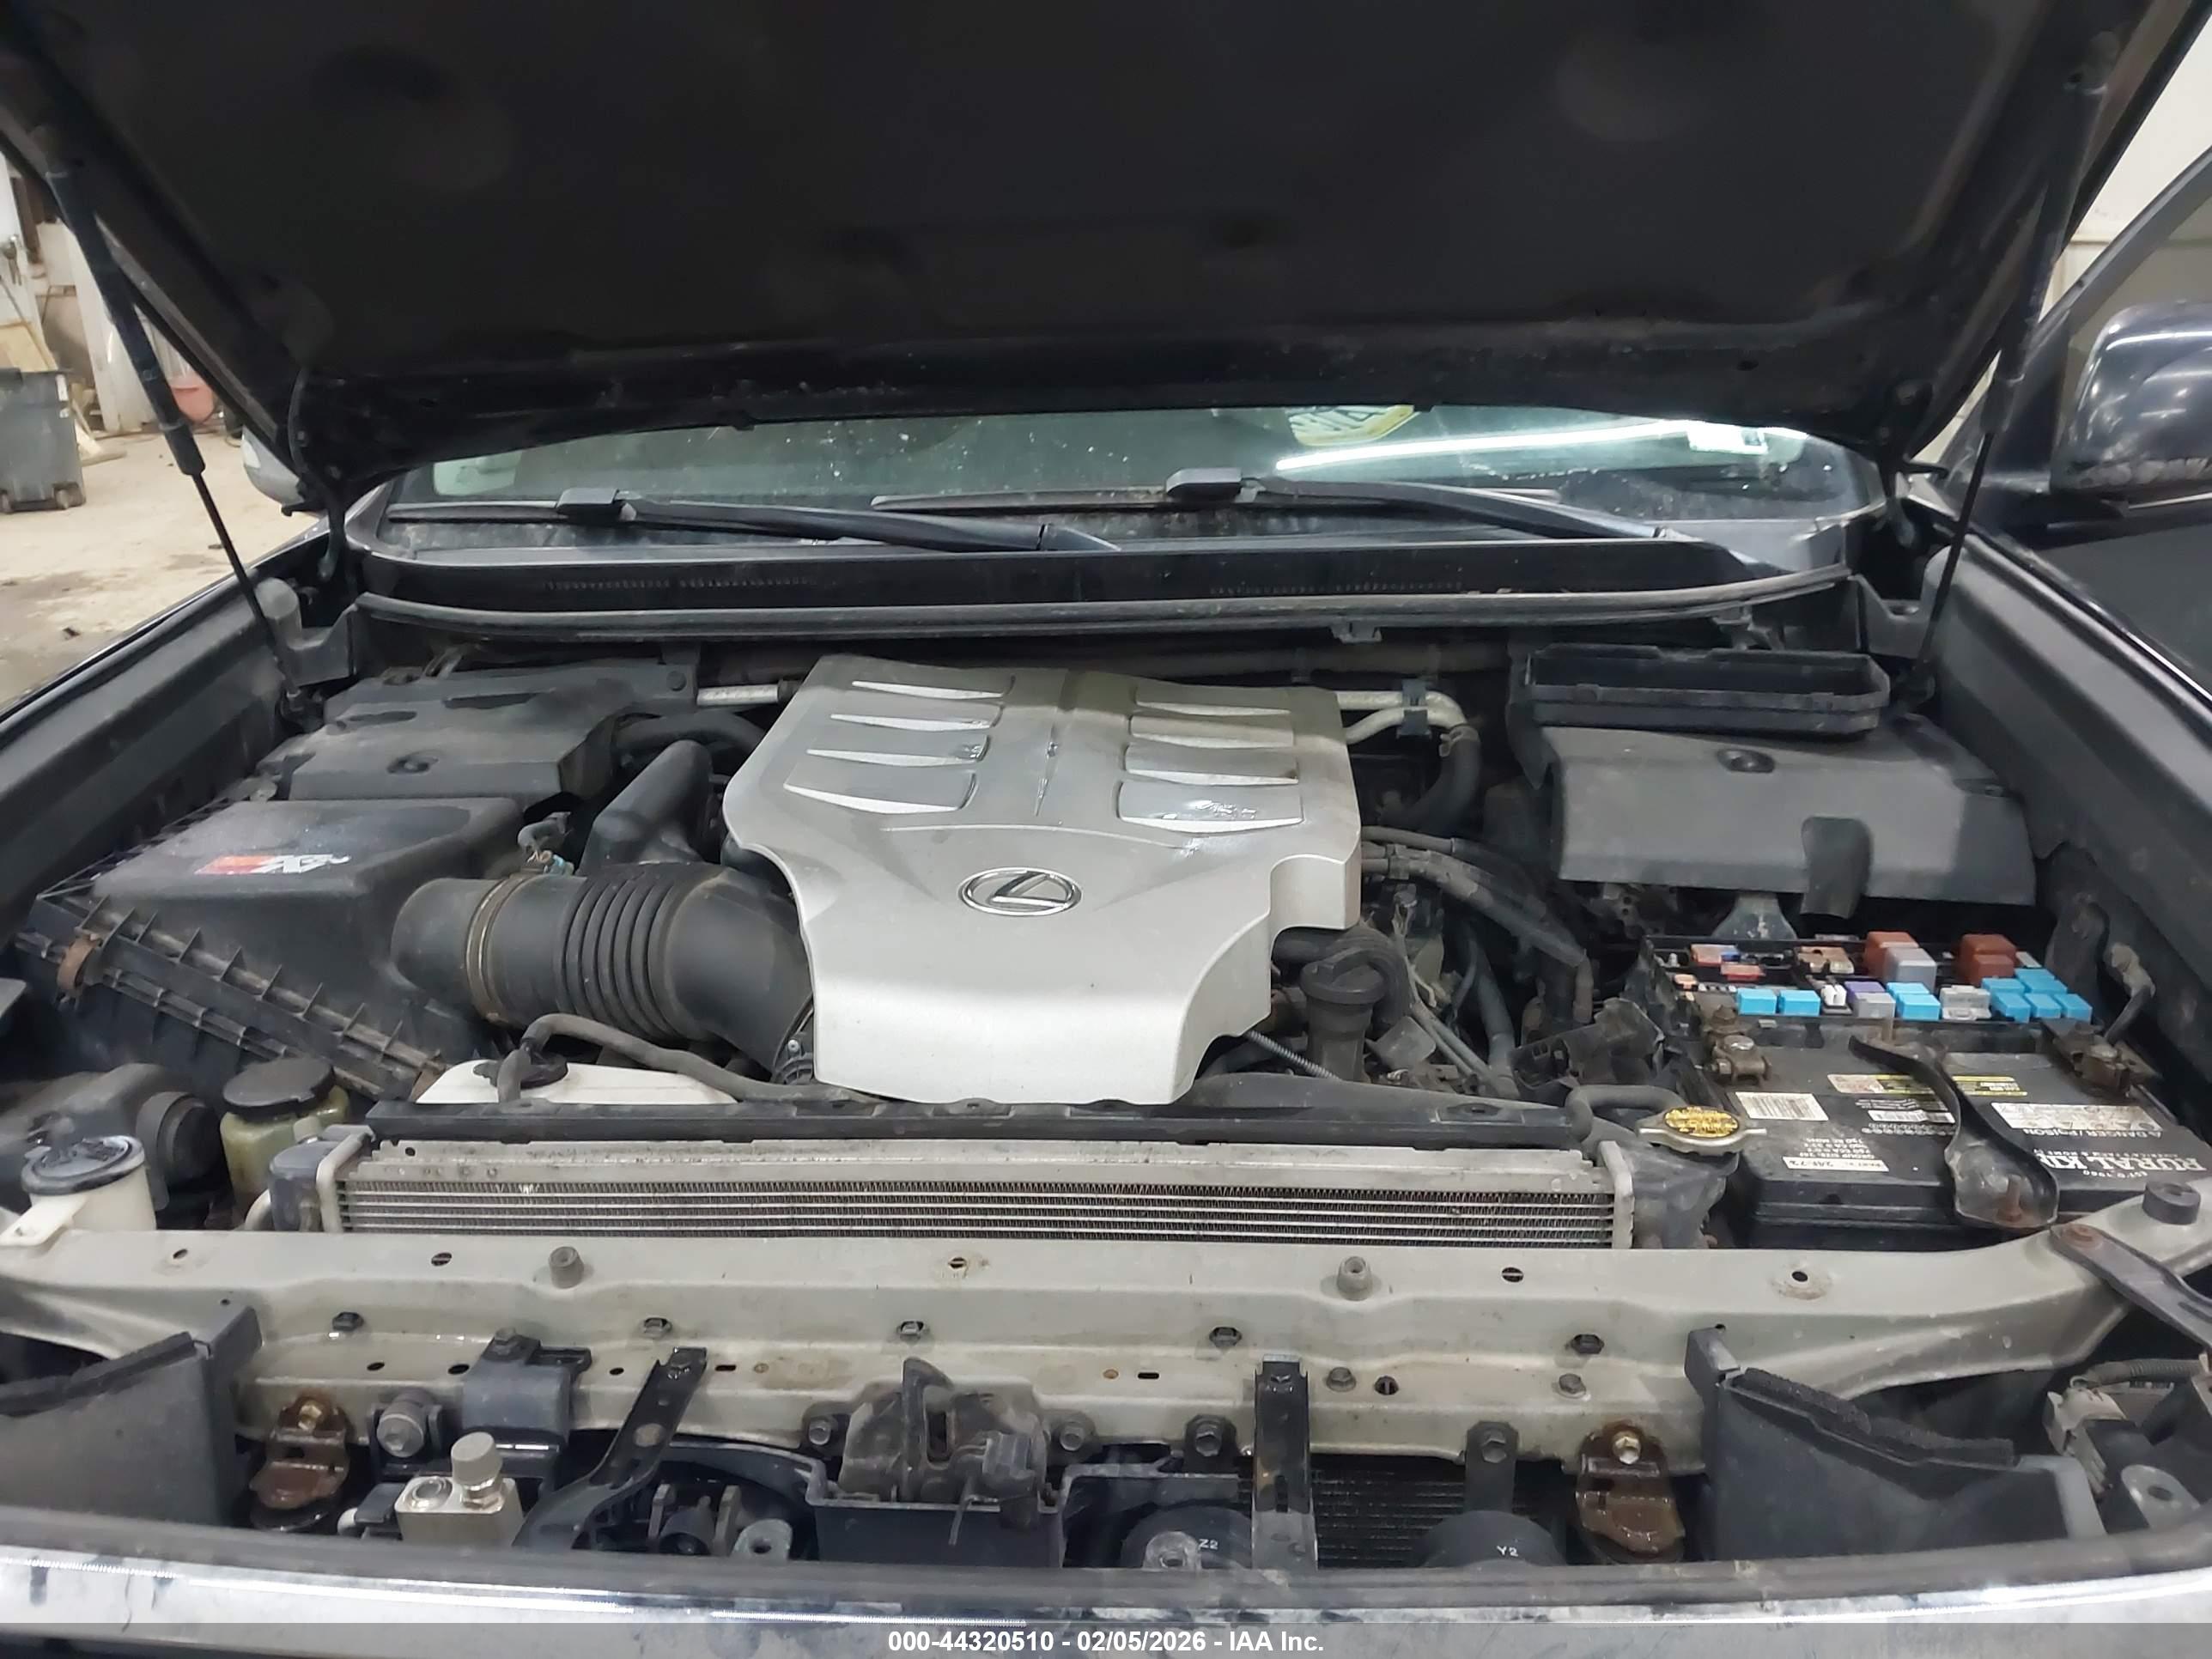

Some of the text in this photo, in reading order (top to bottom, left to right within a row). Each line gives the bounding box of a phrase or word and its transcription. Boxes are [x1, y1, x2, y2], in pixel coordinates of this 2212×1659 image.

[2035, 1154, 2208, 1171] RURAL KIN
[1496, 1545, 1519, 1558] Y2
